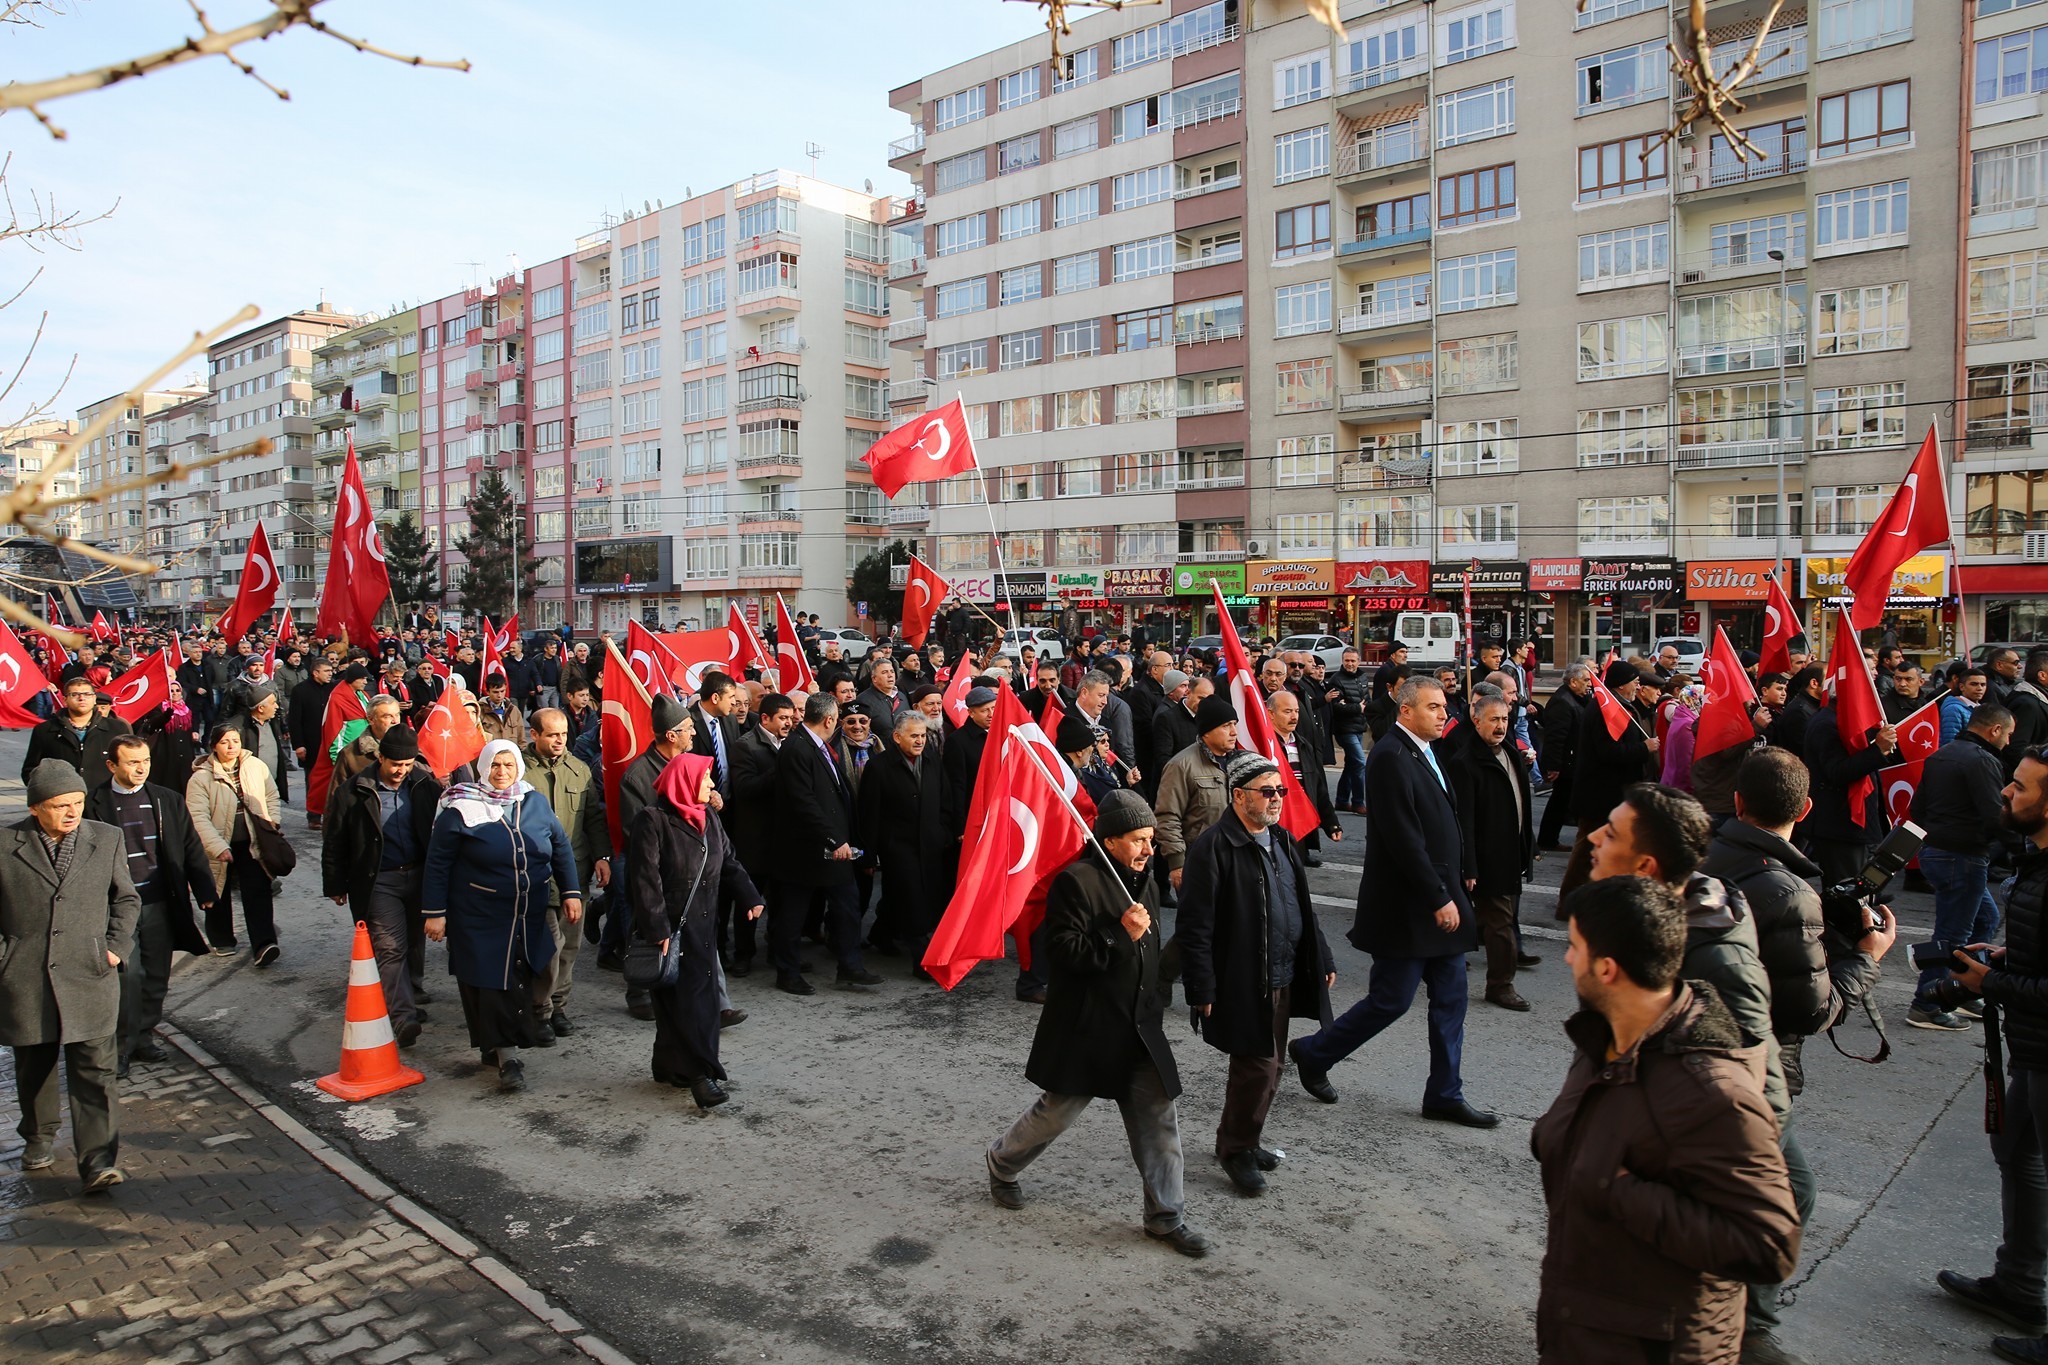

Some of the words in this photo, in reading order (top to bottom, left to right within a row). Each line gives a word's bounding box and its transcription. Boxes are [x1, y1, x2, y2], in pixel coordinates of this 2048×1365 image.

[1262, 563, 1317, 576] BAKLAVACI
[1532, 563, 1581, 577] PİLAVCILAR
[1111, 569, 1163, 585] BAŞAK
[1689, 567, 1758, 588] Süha
[1214, 580, 1241, 590] ÖFTE
[1251, 581, 1329, 592] ANTEPLİOĞLU
[1584, 580, 1617, 591] ERKEK
[1620, 577, 1673, 591] KUAFÖRÜ
[1078, 599, 1095, 608] 333
[1097, 599, 1109, 608] 50
[1237, 596, 1260, 605] KÖFTE
[1364, 598, 1387, 609] 235
[1390, 598, 1405, 609] 07
[1408, 598, 1424, 609] 07
